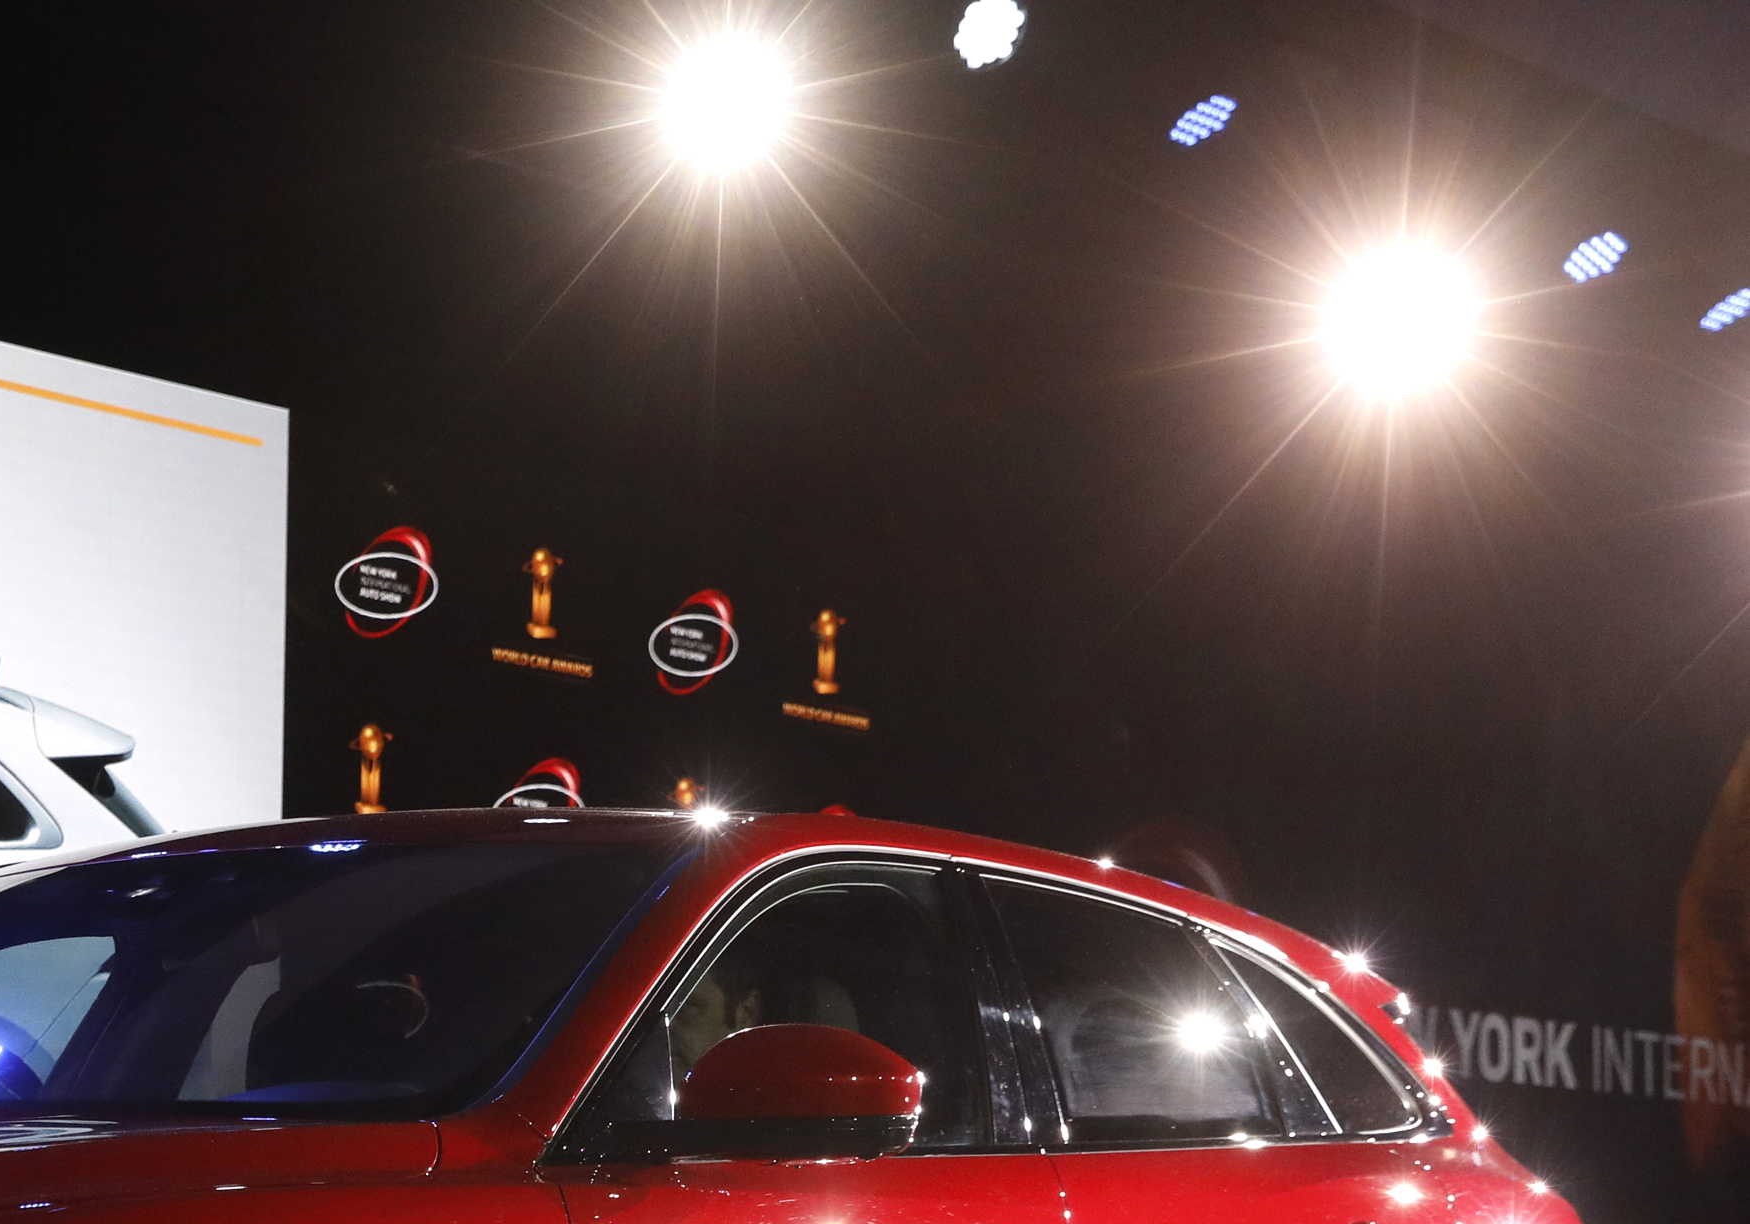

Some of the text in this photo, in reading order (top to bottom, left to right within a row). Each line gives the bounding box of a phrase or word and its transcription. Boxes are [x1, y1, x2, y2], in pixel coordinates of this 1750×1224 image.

[359, 563, 398, 580] NEW YORK
[359, 586, 402, 604] AUTO SHOW
[492, 647, 593, 678] WORLD CAR AWARDS
[1451, 1008, 1578, 1090] YORK
[1592, 1024, 1750, 1110] INTERN
